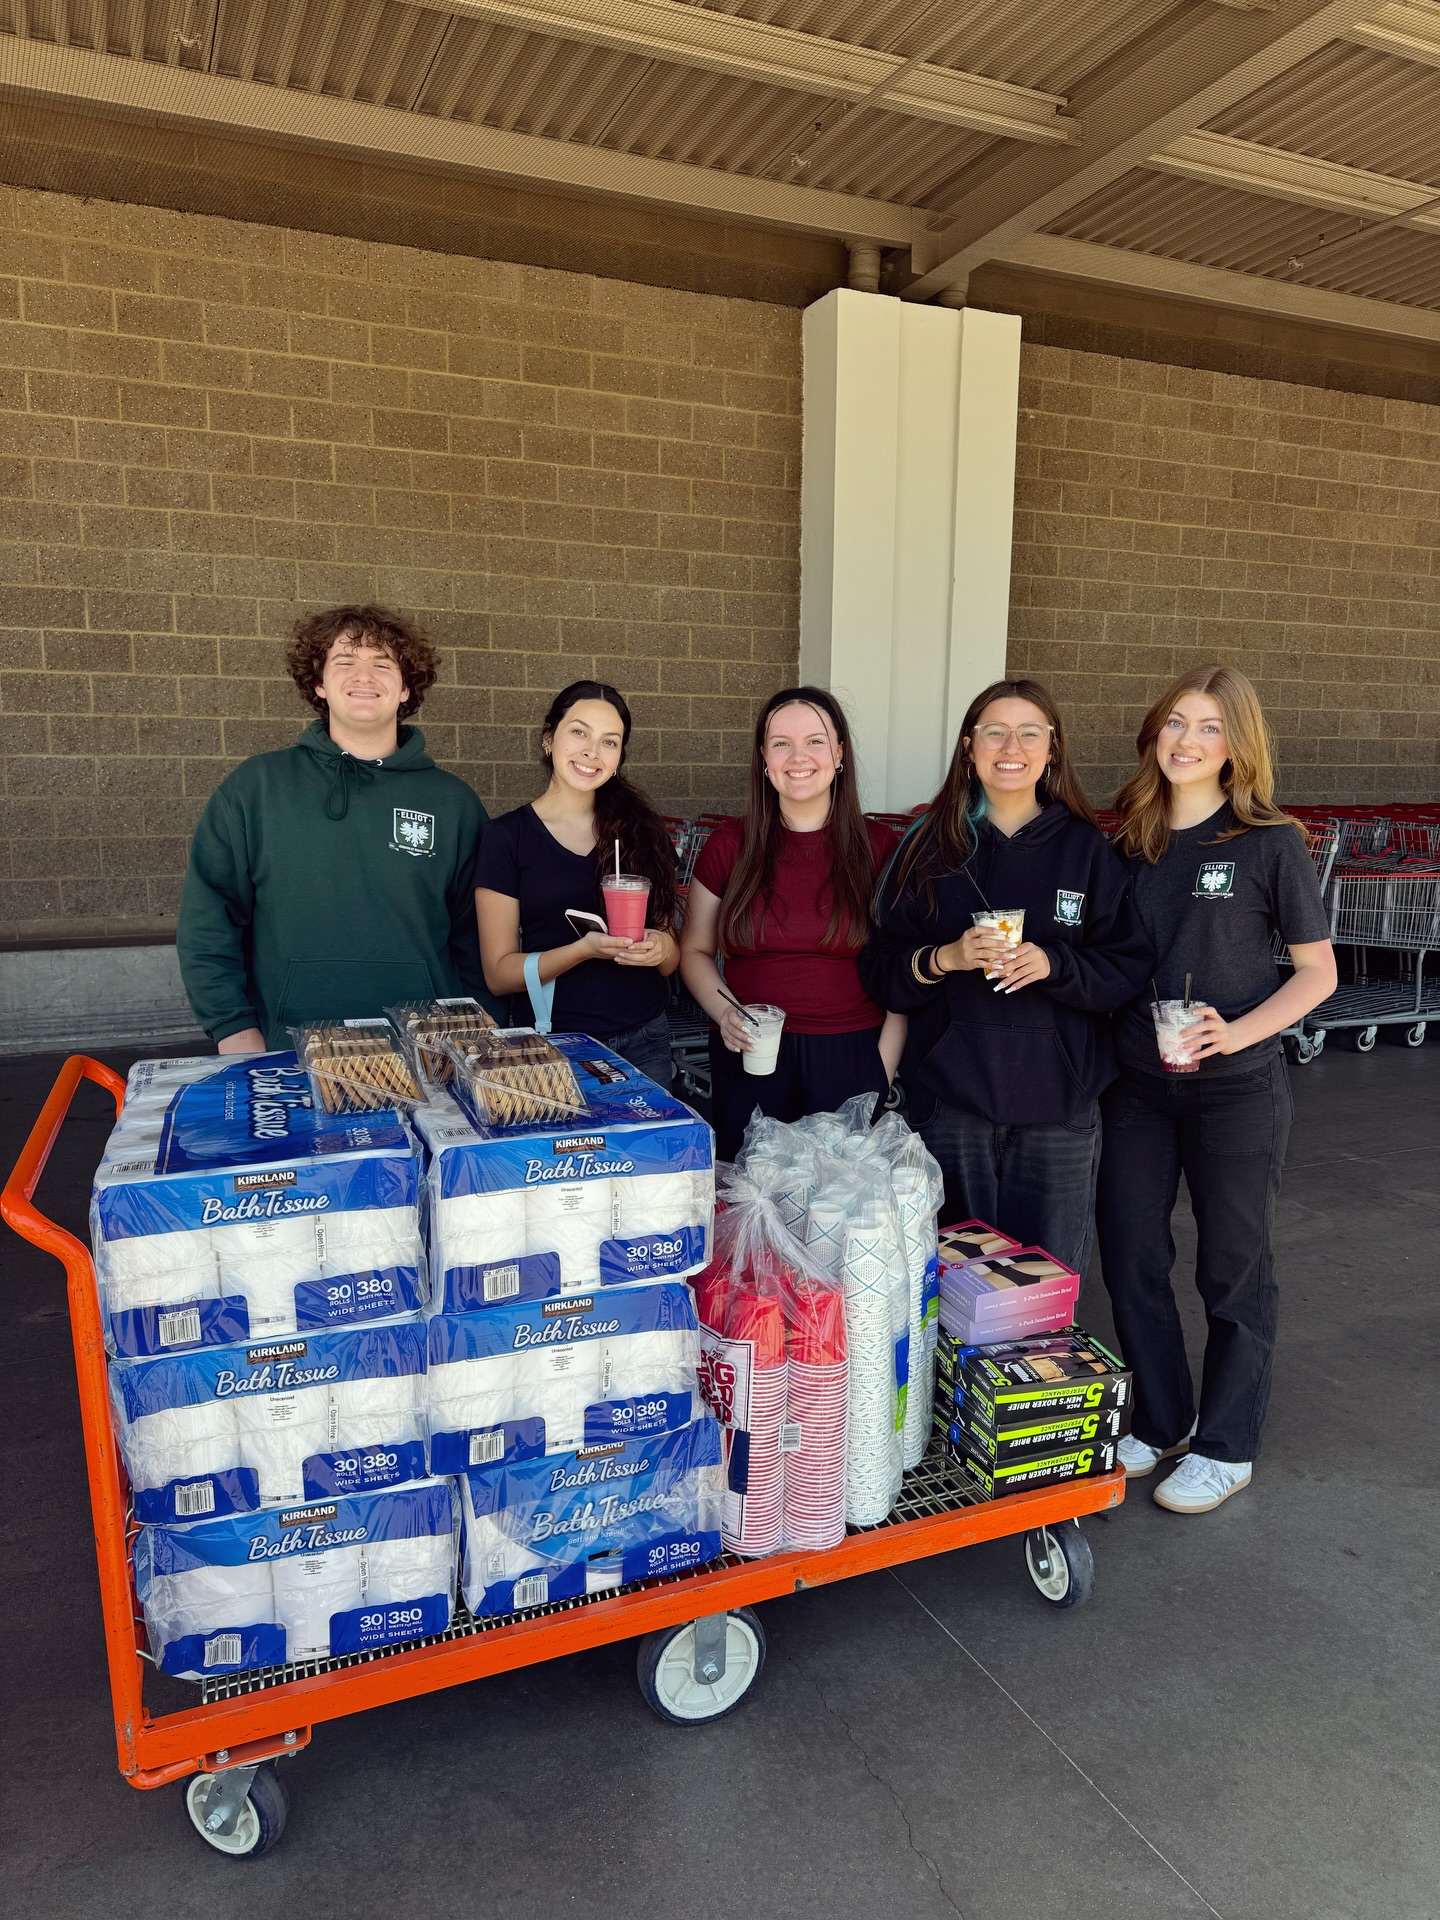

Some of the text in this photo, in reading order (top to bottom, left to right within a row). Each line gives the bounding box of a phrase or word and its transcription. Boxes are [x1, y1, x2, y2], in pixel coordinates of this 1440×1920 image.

[401, 811, 428, 823] ELLIOT
[1062, 892, 1080, 901] ELLIOT
[556, 1136, 604, 1149] KIRKLAND
[525, 1153, 635, 1183] Bath Tissue
[238, 1171, 295, 1186] KIRKLAND
[202, 1190, 330, 1224] Bath Tissue
[626, 1245, 648, 1258] 30
[652, 1239, 683, 1257] 380
[626, 1258, 683, 1272] WIDE SHEETS
[327, 1285, 351, 1300] 30
[356, 1279, 393, 1296] 380
[1023, 1286, 1073, 1302] 5-Pack Seamless Brief
[328, 1300, 395, 1317] WIDE SHEETS
[329, 1299, 351, 1307] ROLLS
[544, 1298, 592, 1312] KIRKLAND
[513, 1316, 620, 1348] Bath Tissue
[249, 1342, 305, 1358] KIRKLAND
[216, 1363, 339, 1396] Bath Tissue
[1041, 1387, 1085, 1397] PERFORMANCE
[1083, 1382, 1105, 1408] 5
[1116, 1381, 1127, 1406] PUMA
[637, 1400, 667, 1417] 380
[986, 1400, 994, 1418] 5
[1007, 1396, 1083, 1411] MEN'S BOXER BRIEF
[612, 1407, 633, 1421] 30
[611, 1418, 667, 1434] WIDE SHEETS
[1041, 1420, 1082, 1433] PERFORMANCE
[1080, 1413, 1100, 1440] 5
[1111, 1411, 1121, 1436] PUMA
[1009, 1428, 1080, 1448] MEN'S BOXER BRIEF
[987, 1438, 996, 1456] 5
[334, 1458, 358, 1472] 30
[362, 1453, 398, 1469] 380
[1036, 1454, 1077, 1468] PERFORMANCE
[1075, 1448, 1095, 1475] 5
[1105, 1445, 1114, 1470] PUMA
[334, 1471, 400, 1487] WIDE SHEETS
[550, 1457, 650, 1491] Bath Tissue
[1006, 1462, 1075, 1484] MEN'S BOXER BRIEF
[984, 1475, 993, 1492] 5
[282, 1505, 336, 1522] KIRKLAND
[532, 1494, 667, 1541] Bath Tissue
[248, 1524, 368, 1560] Bath Tissue
[567, 1537, 583, 1545] Soft
[585, 1534, 599, 1542] and
[648, 1546, 666, 1563] 30
[670, 1541, 700, 1556] 380
[647, 1558, 701, 1575] WIDE SHEETS
[649, 1558, 664, 1567] ROLLS
[360, 1613, 383, 1628] 30
[388, 1608, 423, 1624] 380
[360, 1627, 424, 1642] WIDE SHEETS
